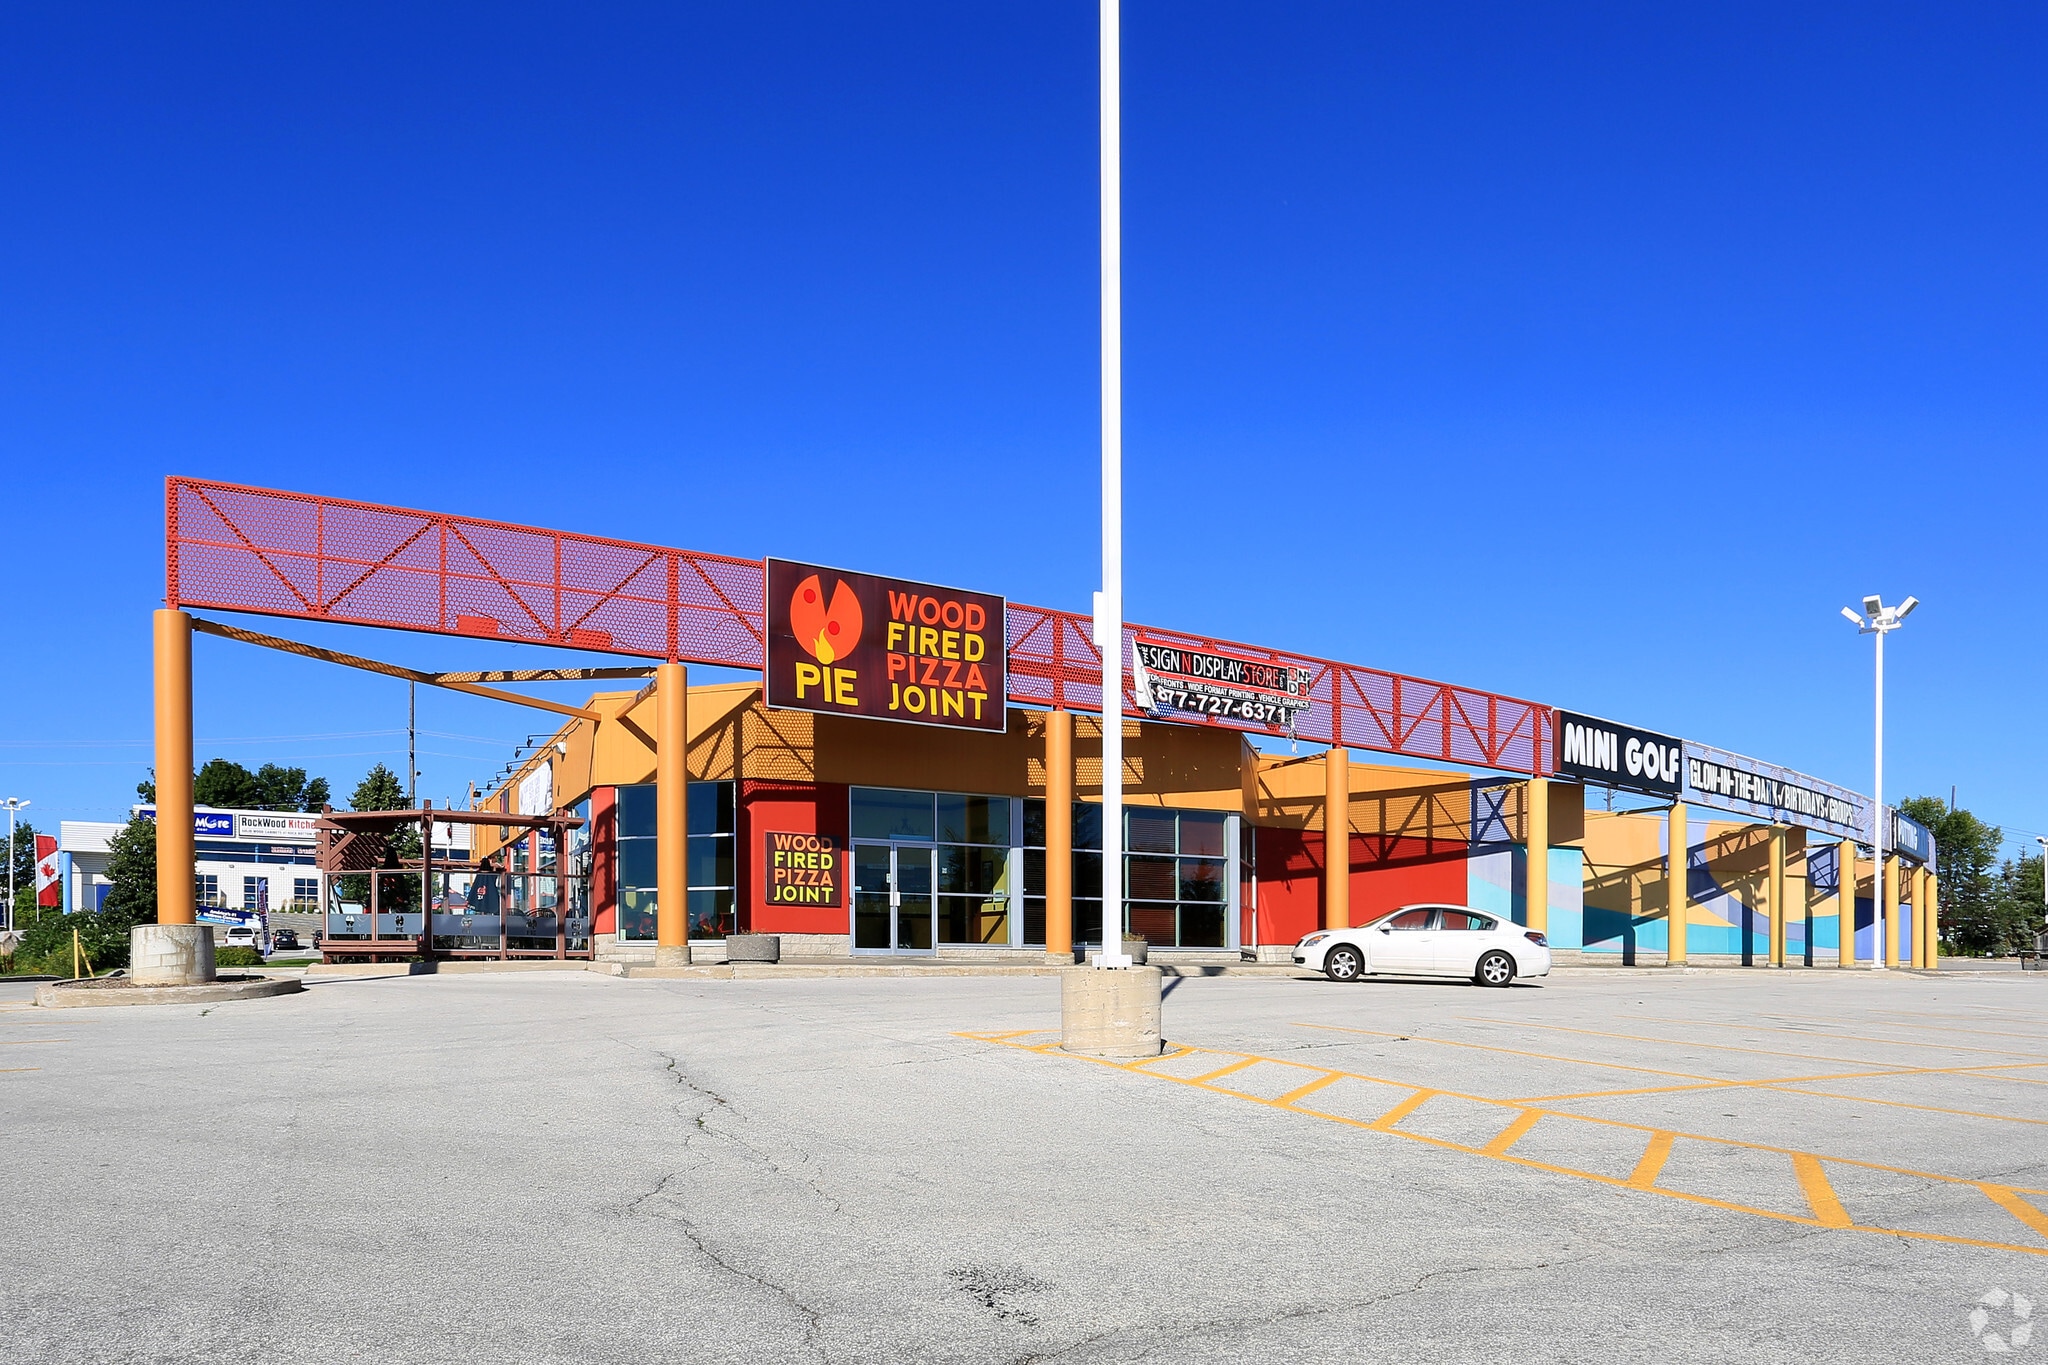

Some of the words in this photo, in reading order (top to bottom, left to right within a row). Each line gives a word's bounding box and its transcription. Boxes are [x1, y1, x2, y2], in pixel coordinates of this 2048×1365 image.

[888, 590, 986, 632] WOOD
[887, 621, 985, 662] FIRED
[795, 662, 858, 706] PIE
[887, 653, 987, 690] PIZZA
[1150, 647, 1180, 672] SIGN
[1182, 653, 1191, 673] N
[1193, 654, 1242, 682] DISPLAY
[1243, 664, 1279, 688] STORE
[888, 682, 988, 720] JOINT
[1188, 682, 1203, 692] WIDE
[1204, 685, 1228, 696] FORMAT
[1228, 688, 1255, 700] PRINTING
[1564, 722, 1618, 772] MINI
[1625, 737, 1680, 783] GOLF
[241, 817, 286, 828] RockWood
[288, 819, 317, 830] Kitche
[774, 834, 833, 853] WOOD
[774, 851, 834, 870] FIRED
[774, 868, 834, 887] PIZZA
[774, 885, 834, 903] JOINT
